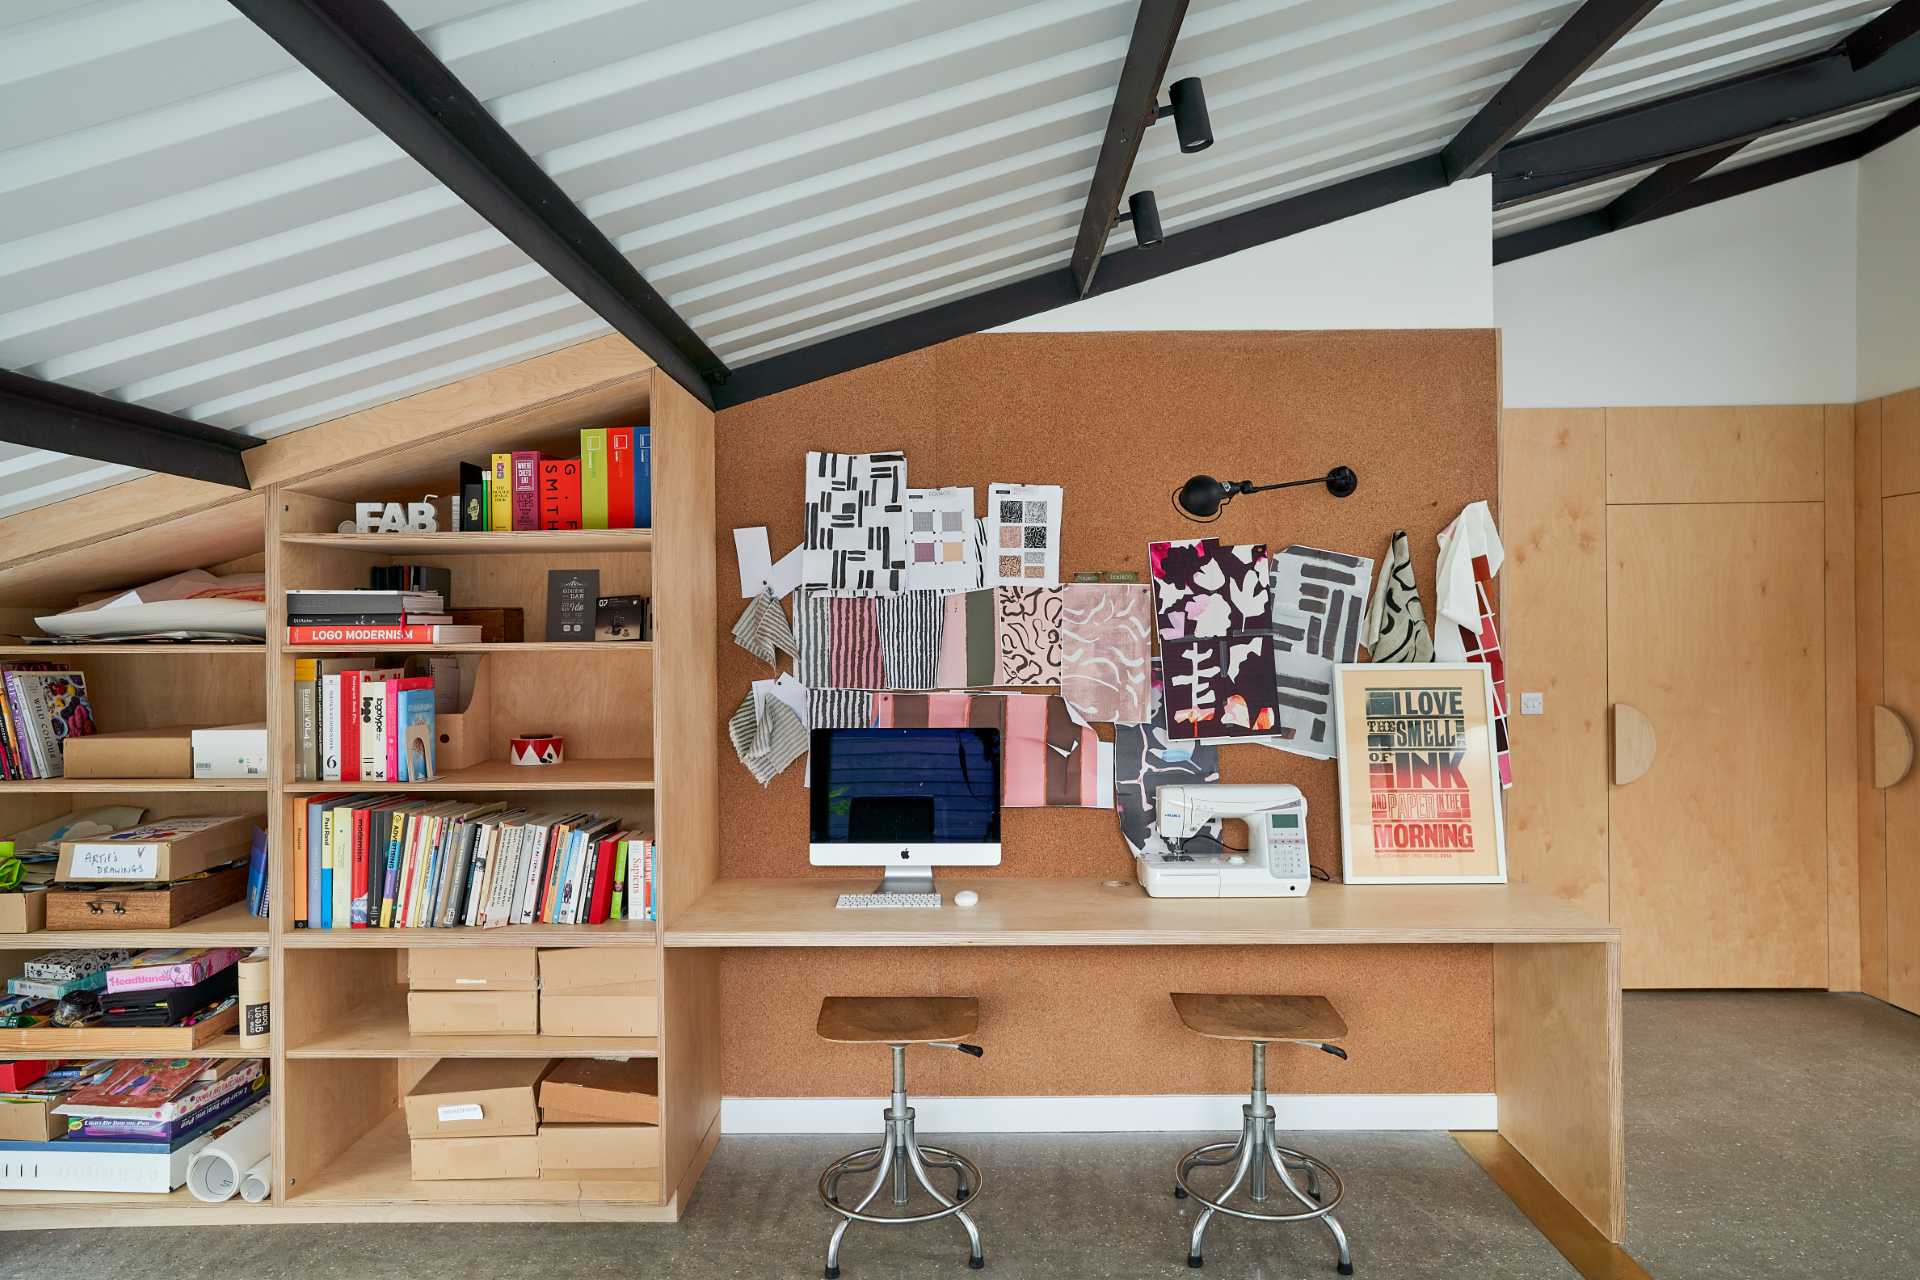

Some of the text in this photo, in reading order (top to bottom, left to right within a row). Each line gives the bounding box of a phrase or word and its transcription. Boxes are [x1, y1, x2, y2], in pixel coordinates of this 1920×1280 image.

[355, 502, 438, 533] FAB
[312, 629, 413, 641] LOGO MODERNISM
[375, 698, 384, 732] logotype
[1394, 690, 1464, 714] I LOVE
[1367, 720, 1456, 747] THE SMELL
[1369, 752, 1468, 788] OF INK
[1372, 794, 1386, 810] AND
[1388, 793, 1436, 819] PAPER
[1446, 793, 1460, 809] THE
[388, 825, 399, 870] ADVERTISING
[1374, 824, 1474, 848] MORNING
[631, 857, 642, 894] Sapiens
[254, 1007, 264, 1032] green
